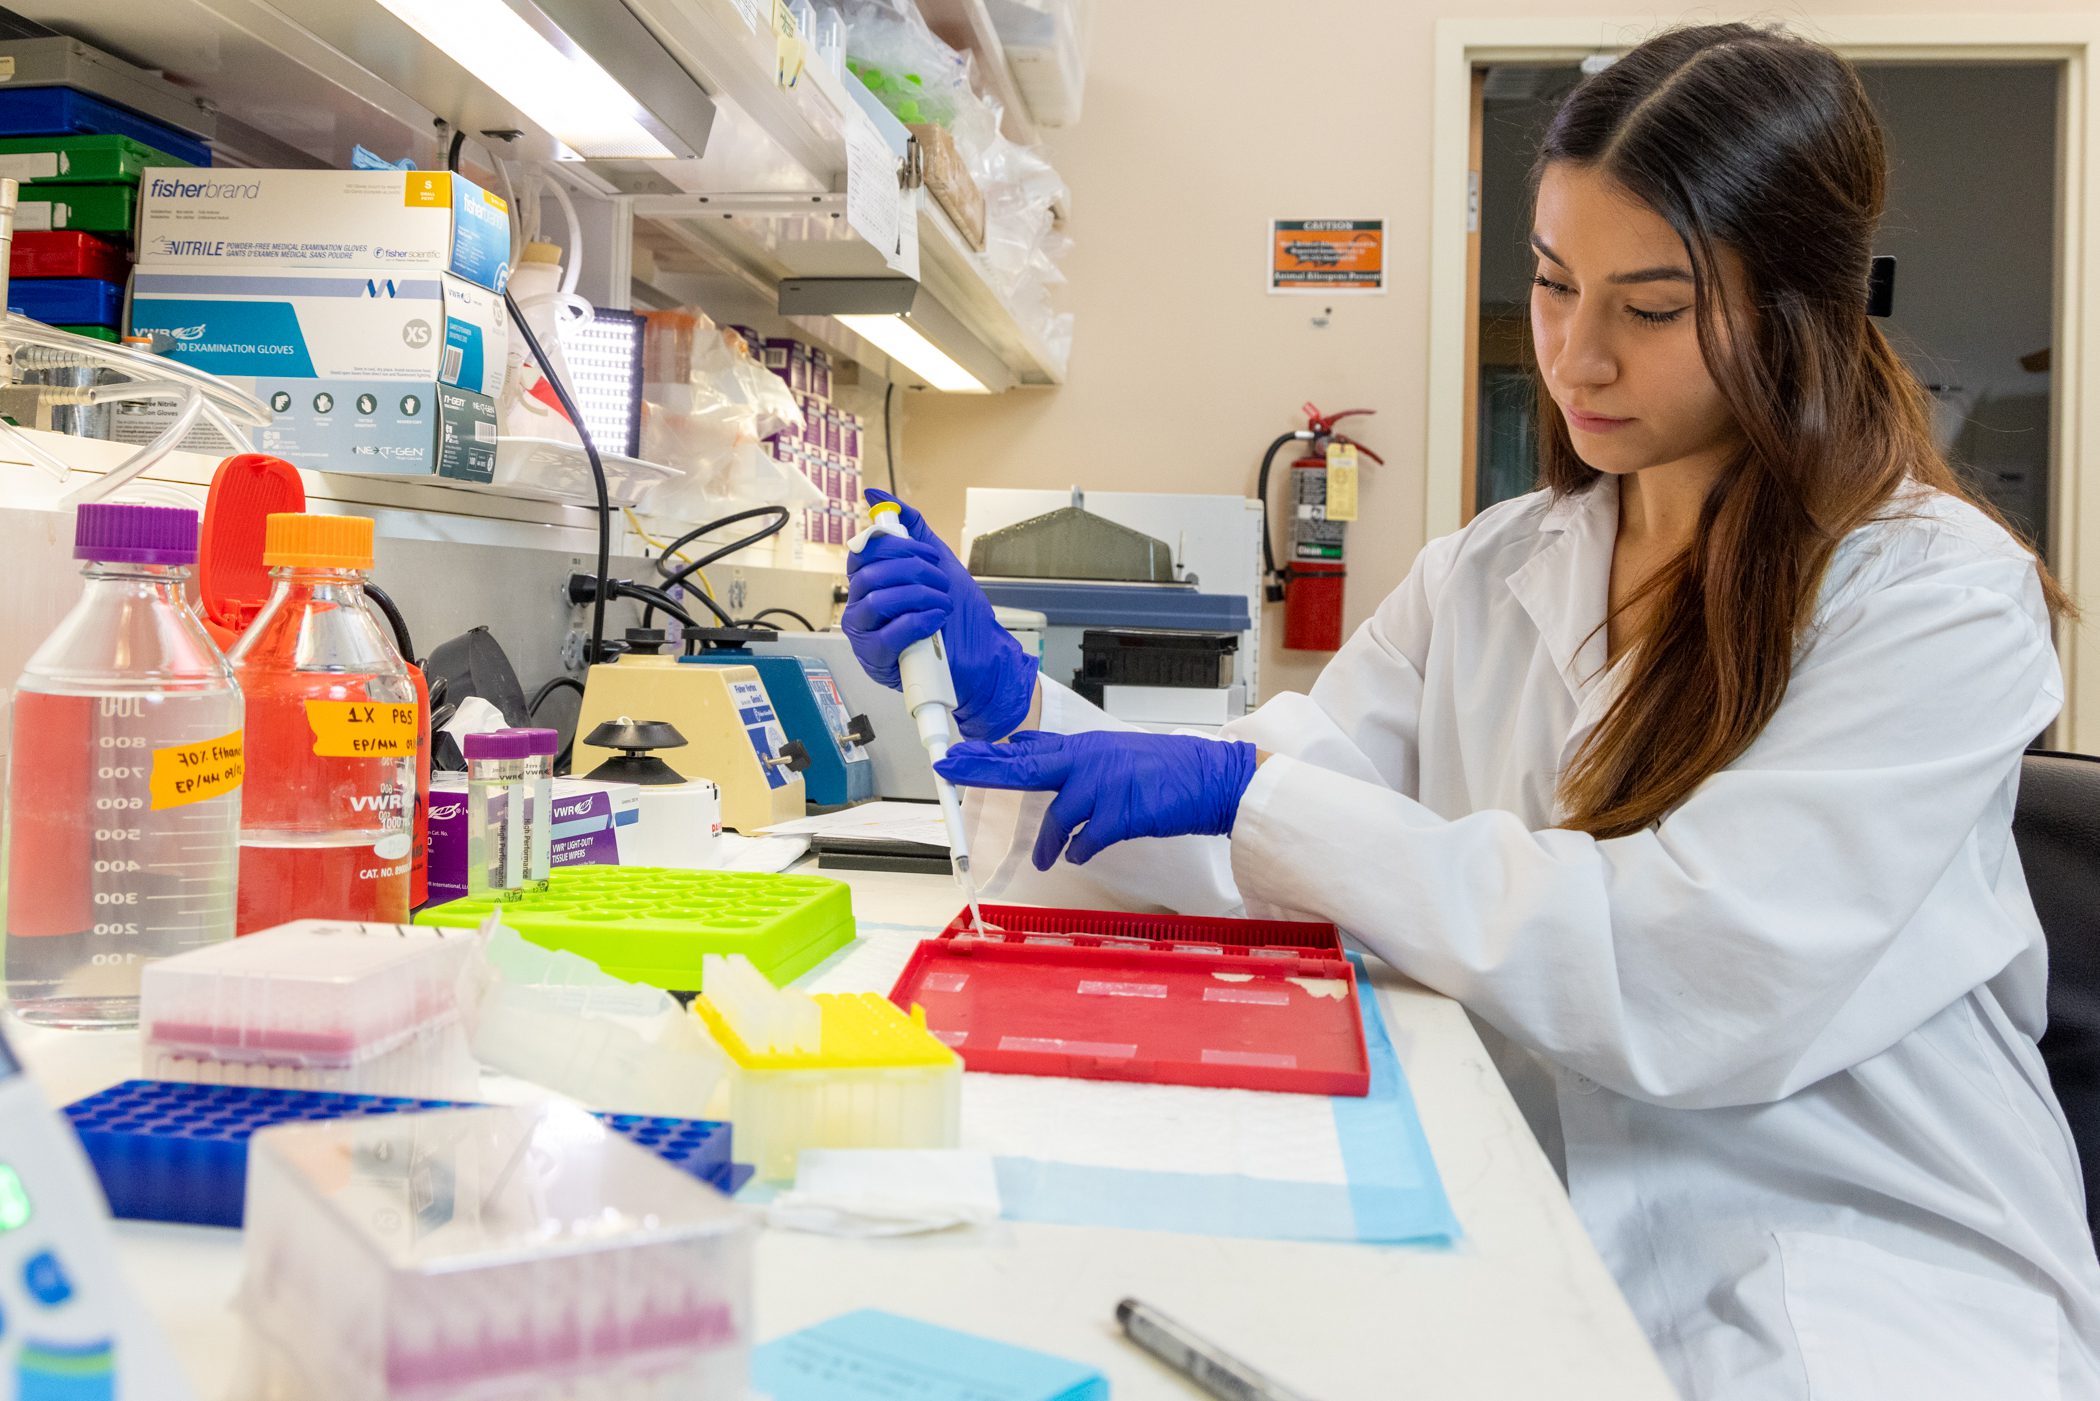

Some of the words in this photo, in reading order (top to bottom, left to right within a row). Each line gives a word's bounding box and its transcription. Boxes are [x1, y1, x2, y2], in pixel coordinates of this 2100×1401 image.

[151, 179, 261, 199] fisherbrand
[424, 180, 433, 189] S
[1303, 221, 1353, 230] CAUTION
[171, 241, 224, 256] NITRILE
[226, 242, 271, 250] POWDER-FREE
[272, 243, 299, 251] MEDICAL
[300, 243, 342, 252] EXAMINATION
[343, 244, 368, 252] GLOVES
[226, 249, 246, 257] GANTS
[309, 251, 327, 259] SANS
[327, 251, 354, 260] POUDRE
[405, 326, 429, 343] XS
[188, 343, 256, 353] EXAMINATION
[257, 345, 295, 355] GLOVES
[347, 706, 375, 723] 1X
[392, 708, 413, 725] PBS
[350, 795, 401, 812] VWR
[554, 805, 575, 818] VWR
[567, 837, 594, 850] LIGHT-DUTY
[522, 831, 531, 879] Performance
[551, 851, 569, 864] TISSUE
[568, 849, 586, 860] WIPERS
[359, 868, 379, 880] CAT.
[380, 867, 394, 877] NO.
[433, 882, 461, 890] International,
